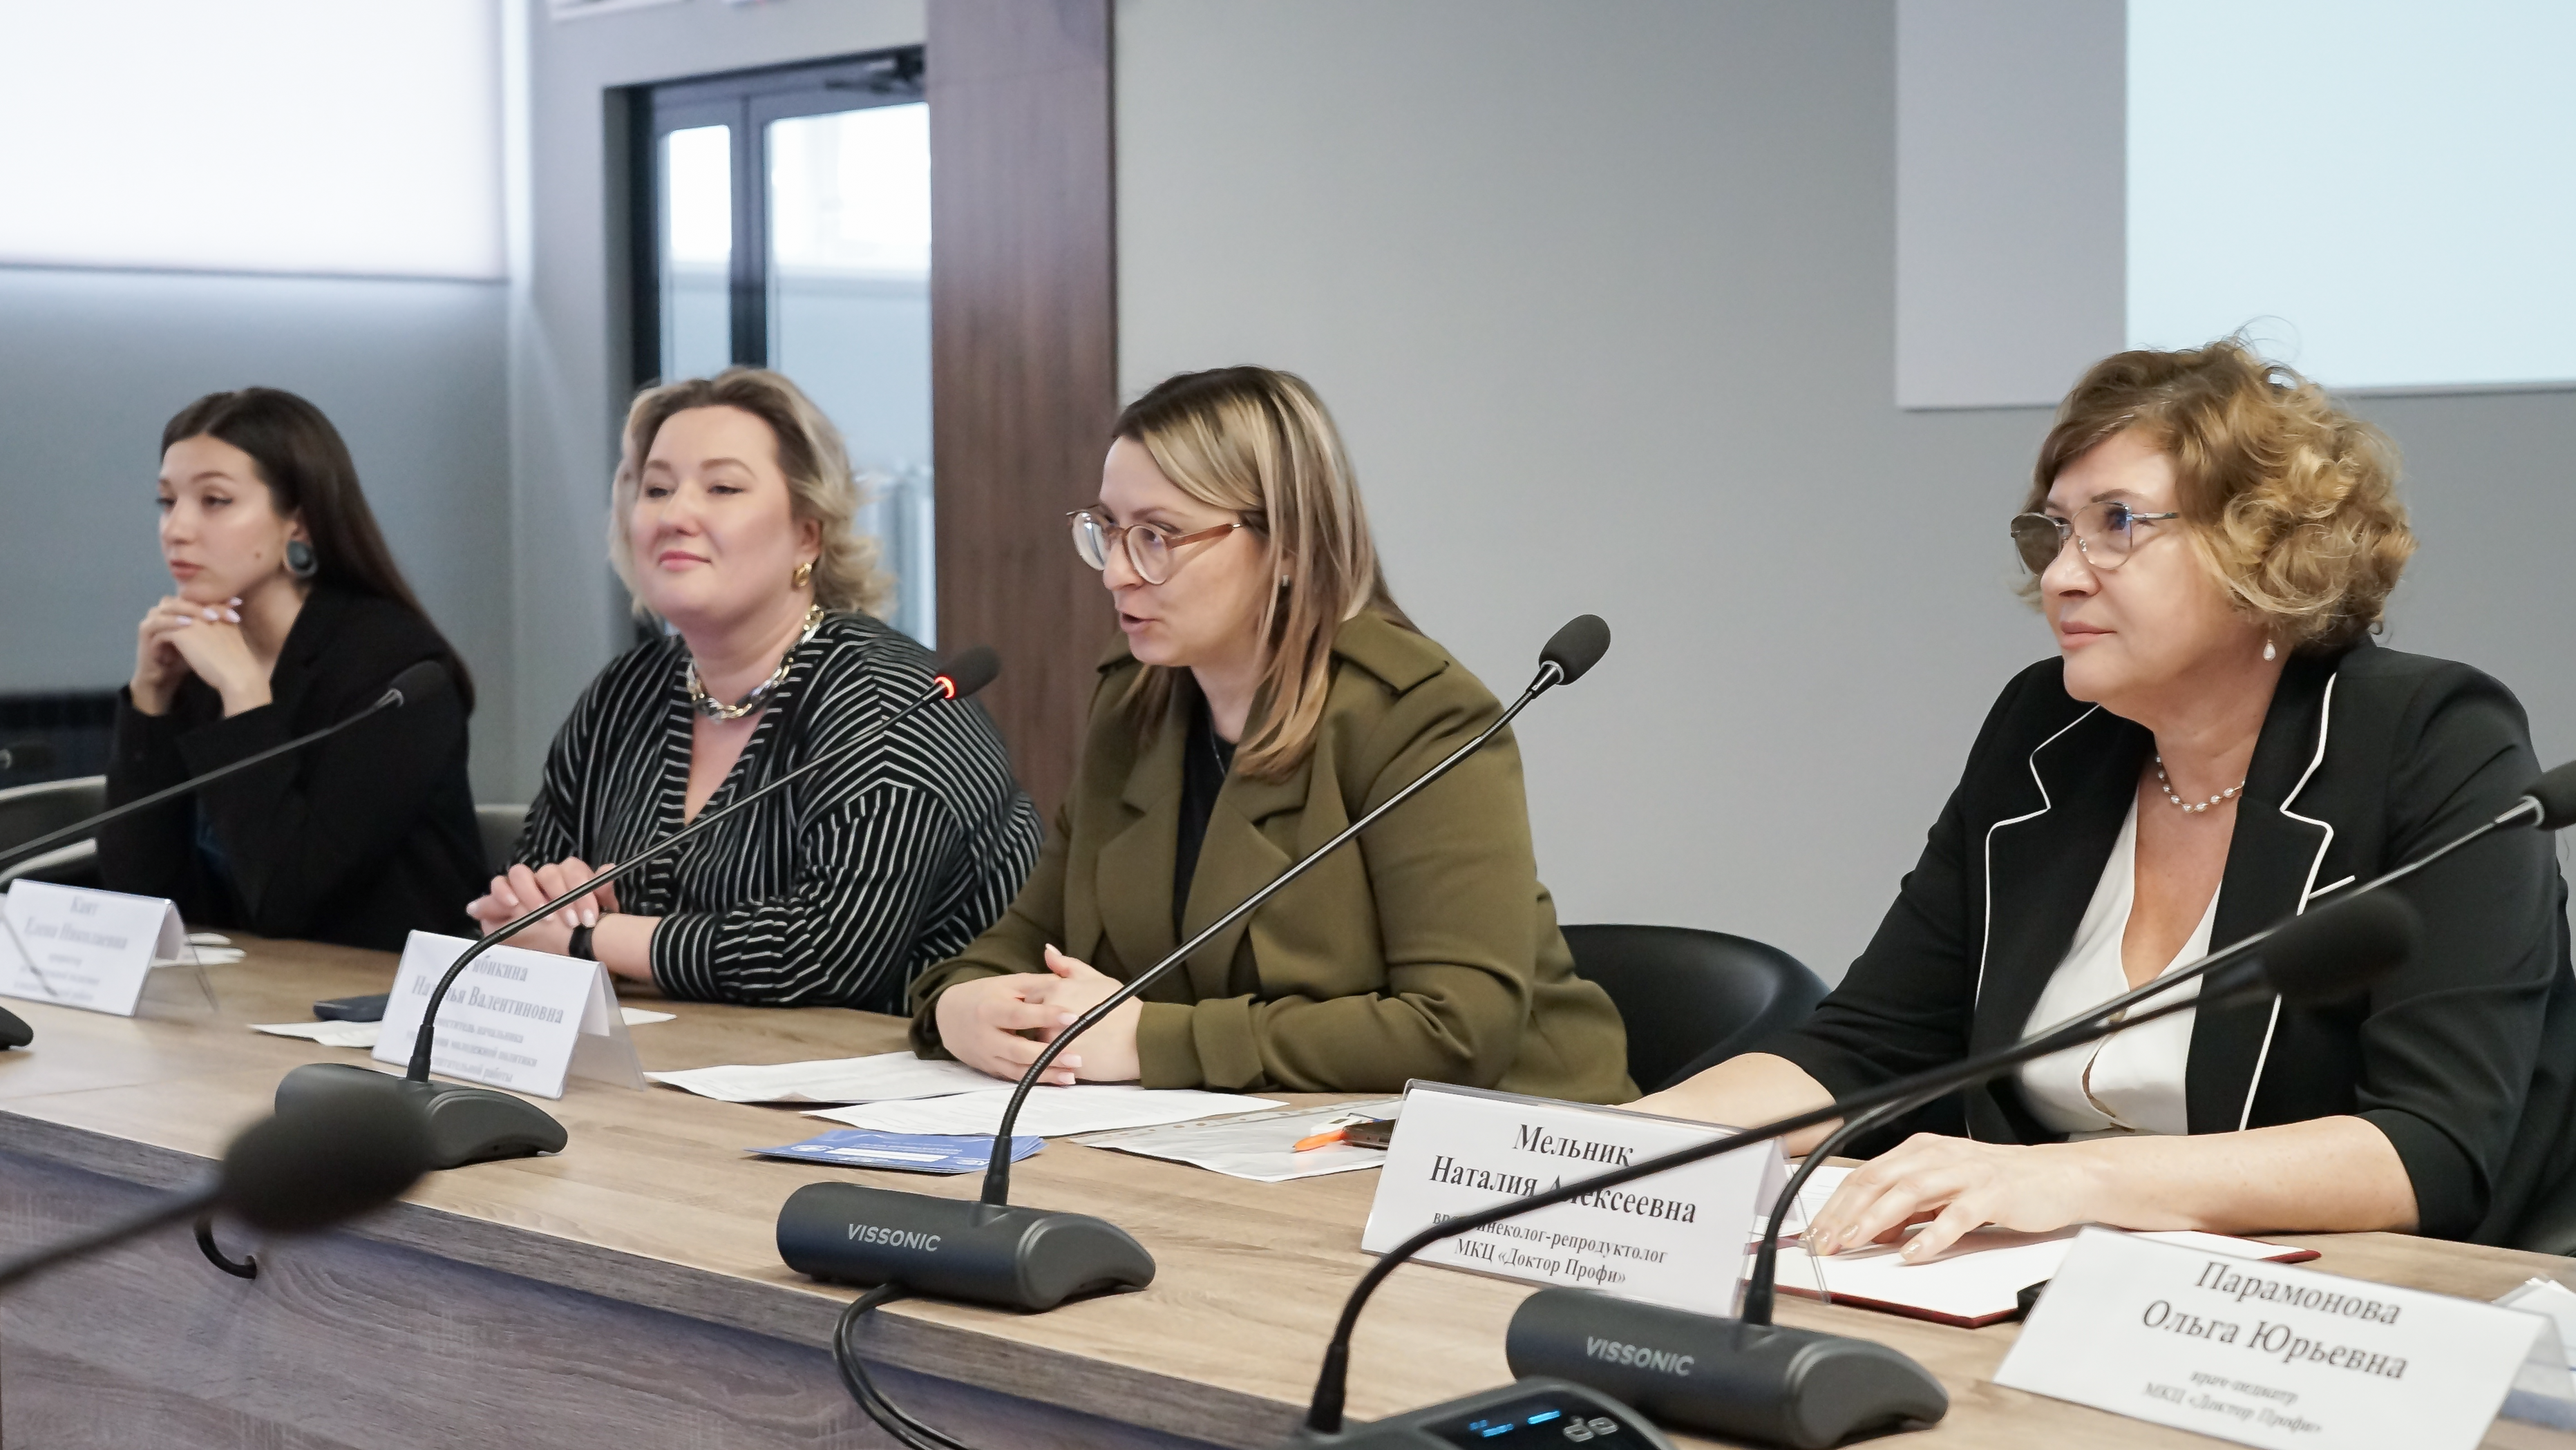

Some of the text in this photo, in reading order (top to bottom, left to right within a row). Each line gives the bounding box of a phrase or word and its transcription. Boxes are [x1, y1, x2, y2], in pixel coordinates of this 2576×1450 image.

[465, 955, 529, 982] ябикина
[468, 986, 564, 1024] Валентиновна
[1513, 1123, 1633, 1167] Мельник
[1429, 1155, 1538, 1198] Наталия
[847, 1223, 941, 1252] VISSONIC
[1454, 1238, 1627, 1285] МКЦ «Доктор Профи»
[2195, 1261, 2402, 1326] Парамонова
[1587, 1336, 1695, 1377] VISSONIC
[2143, 1299, 2407, 1380] Ольга Юрьевна
